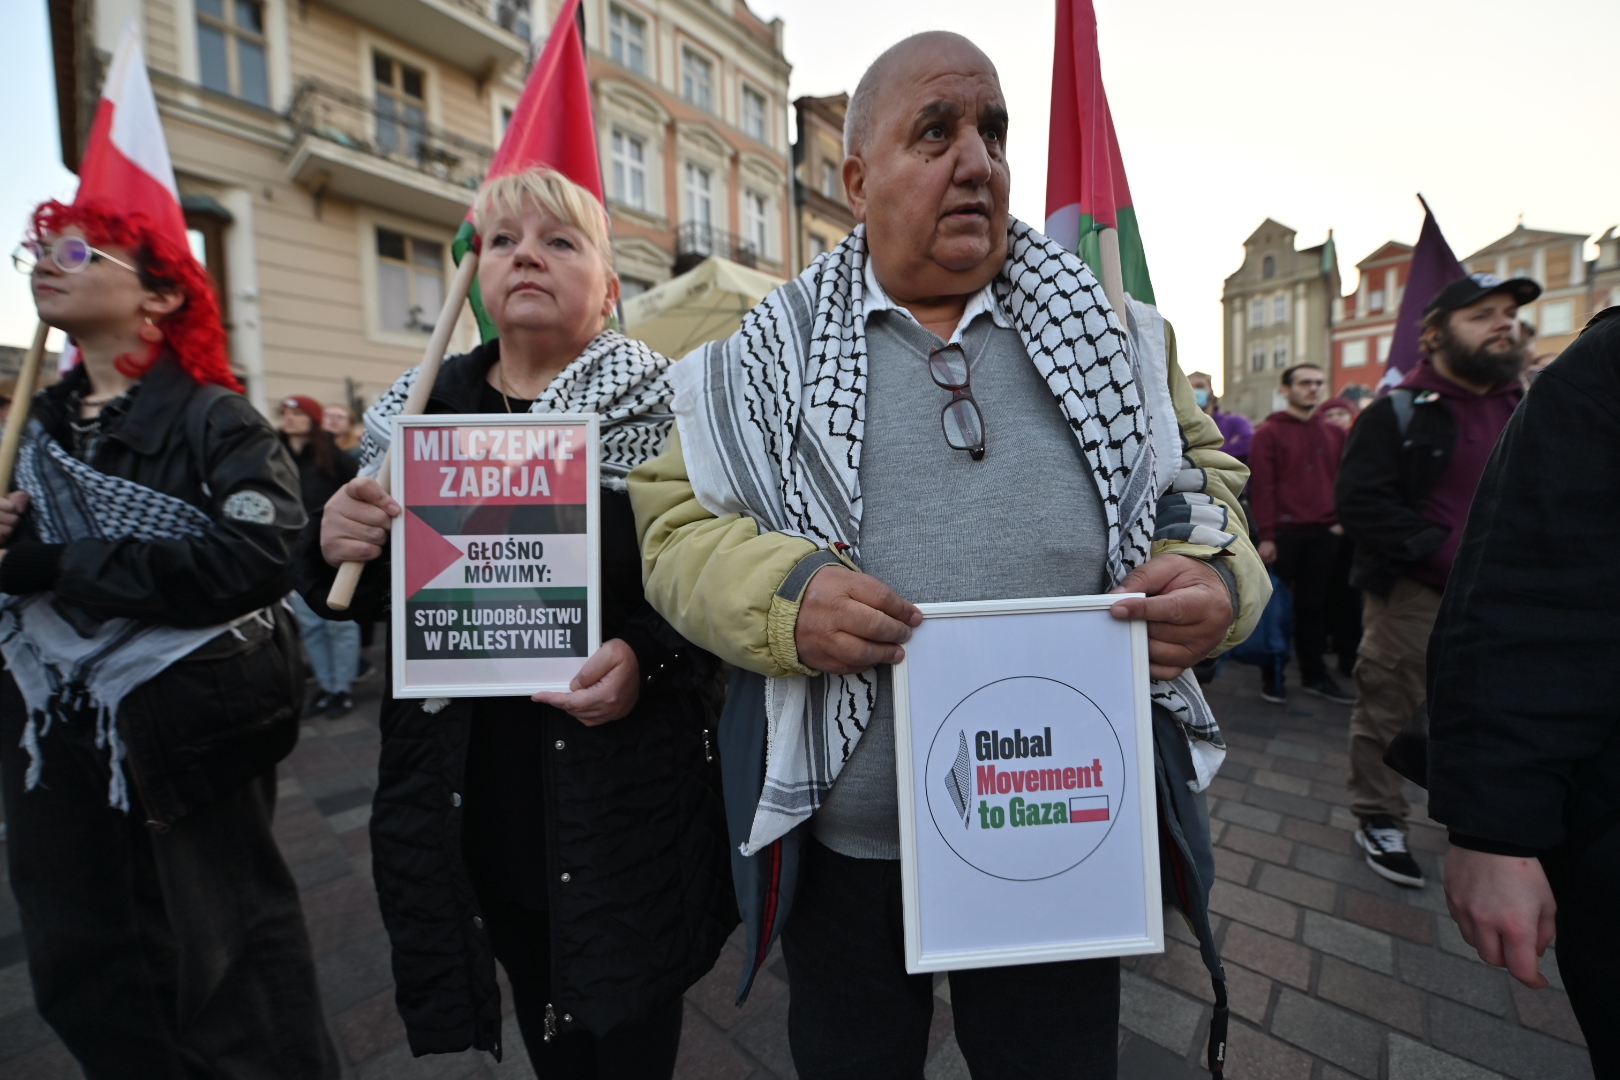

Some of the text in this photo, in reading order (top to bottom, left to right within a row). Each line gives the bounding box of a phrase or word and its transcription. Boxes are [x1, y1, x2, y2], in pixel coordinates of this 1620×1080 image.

[413, 429, 574, 461] MILCZENIE
[439, 466, 551, 498] ZABIJA
[467, 538, 544, 561] GŁOŚNO
[464, 562, 552, 584] MÓWIMY:
[414, 605, 582, 627] STOP LUDOBÓJSTWU
[424, 629, 572, 651] W PALESTYNIE!
[974, 726, 1052, 761] Global
[976, 758, 1103, 796] Movement
[977, 796, 1068, 829] to Gaza
